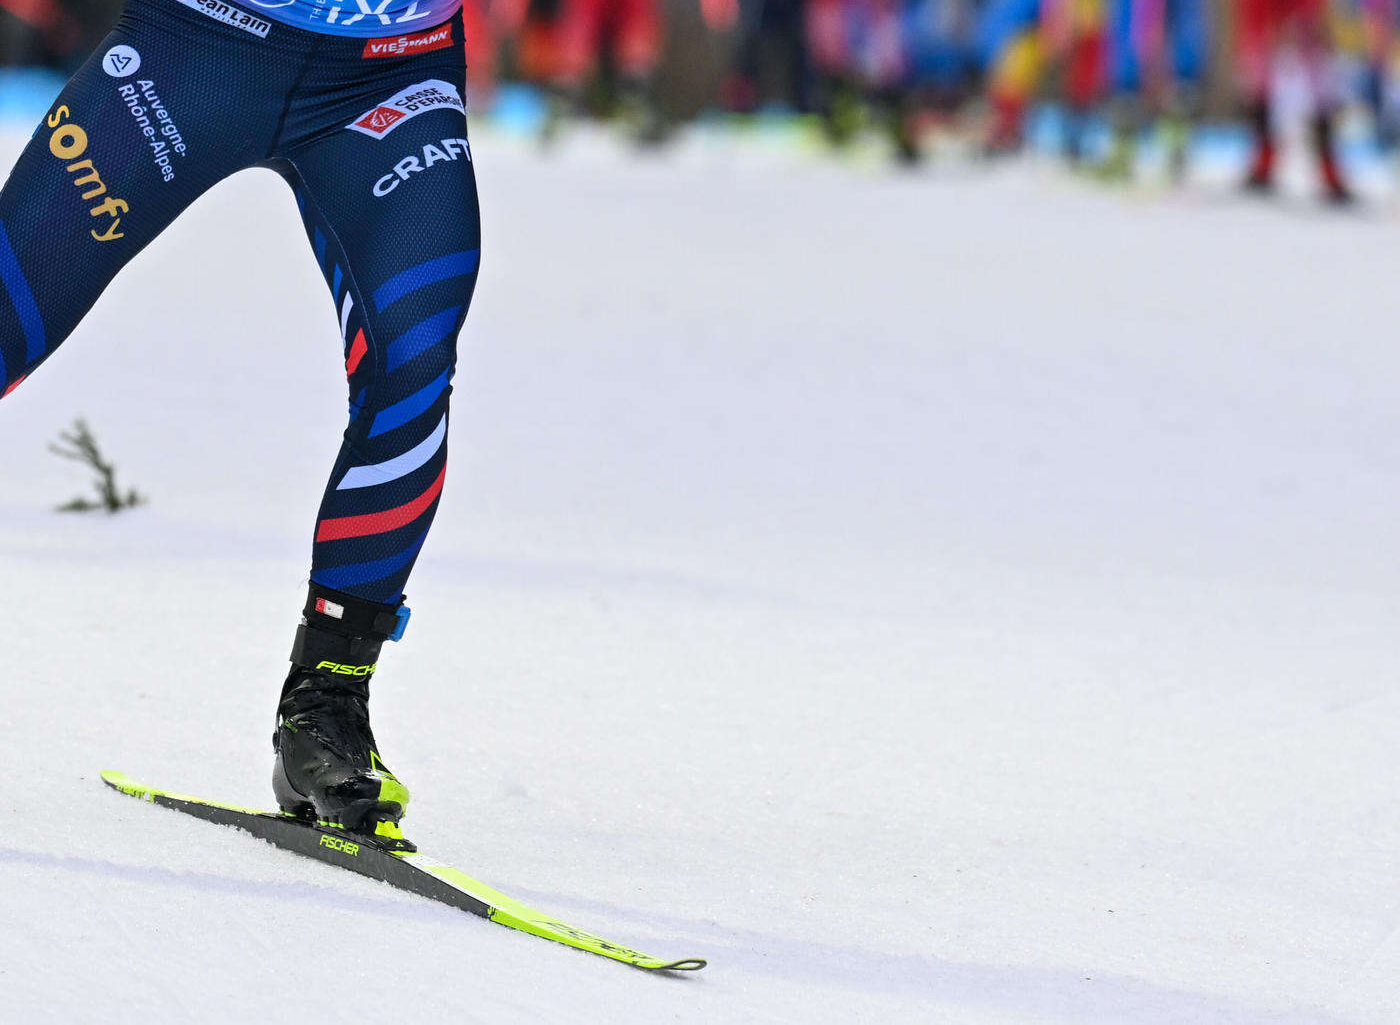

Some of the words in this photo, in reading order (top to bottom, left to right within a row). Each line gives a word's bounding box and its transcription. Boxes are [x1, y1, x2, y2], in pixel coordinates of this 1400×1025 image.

[230, 10, 269, 33] Lain
[371, 30, 448, 54] VIESSMANN
[395, 88, 442, 107] CAISSE
[118, 84, 175, 183] Rhône-Alpes
[137, 79, 188, 158] Auvergne-
[48, 105, 129, 241] somfy
[373, 138, 471, 197] CRAFT
[320, 835, 359, 856] FISCHER
